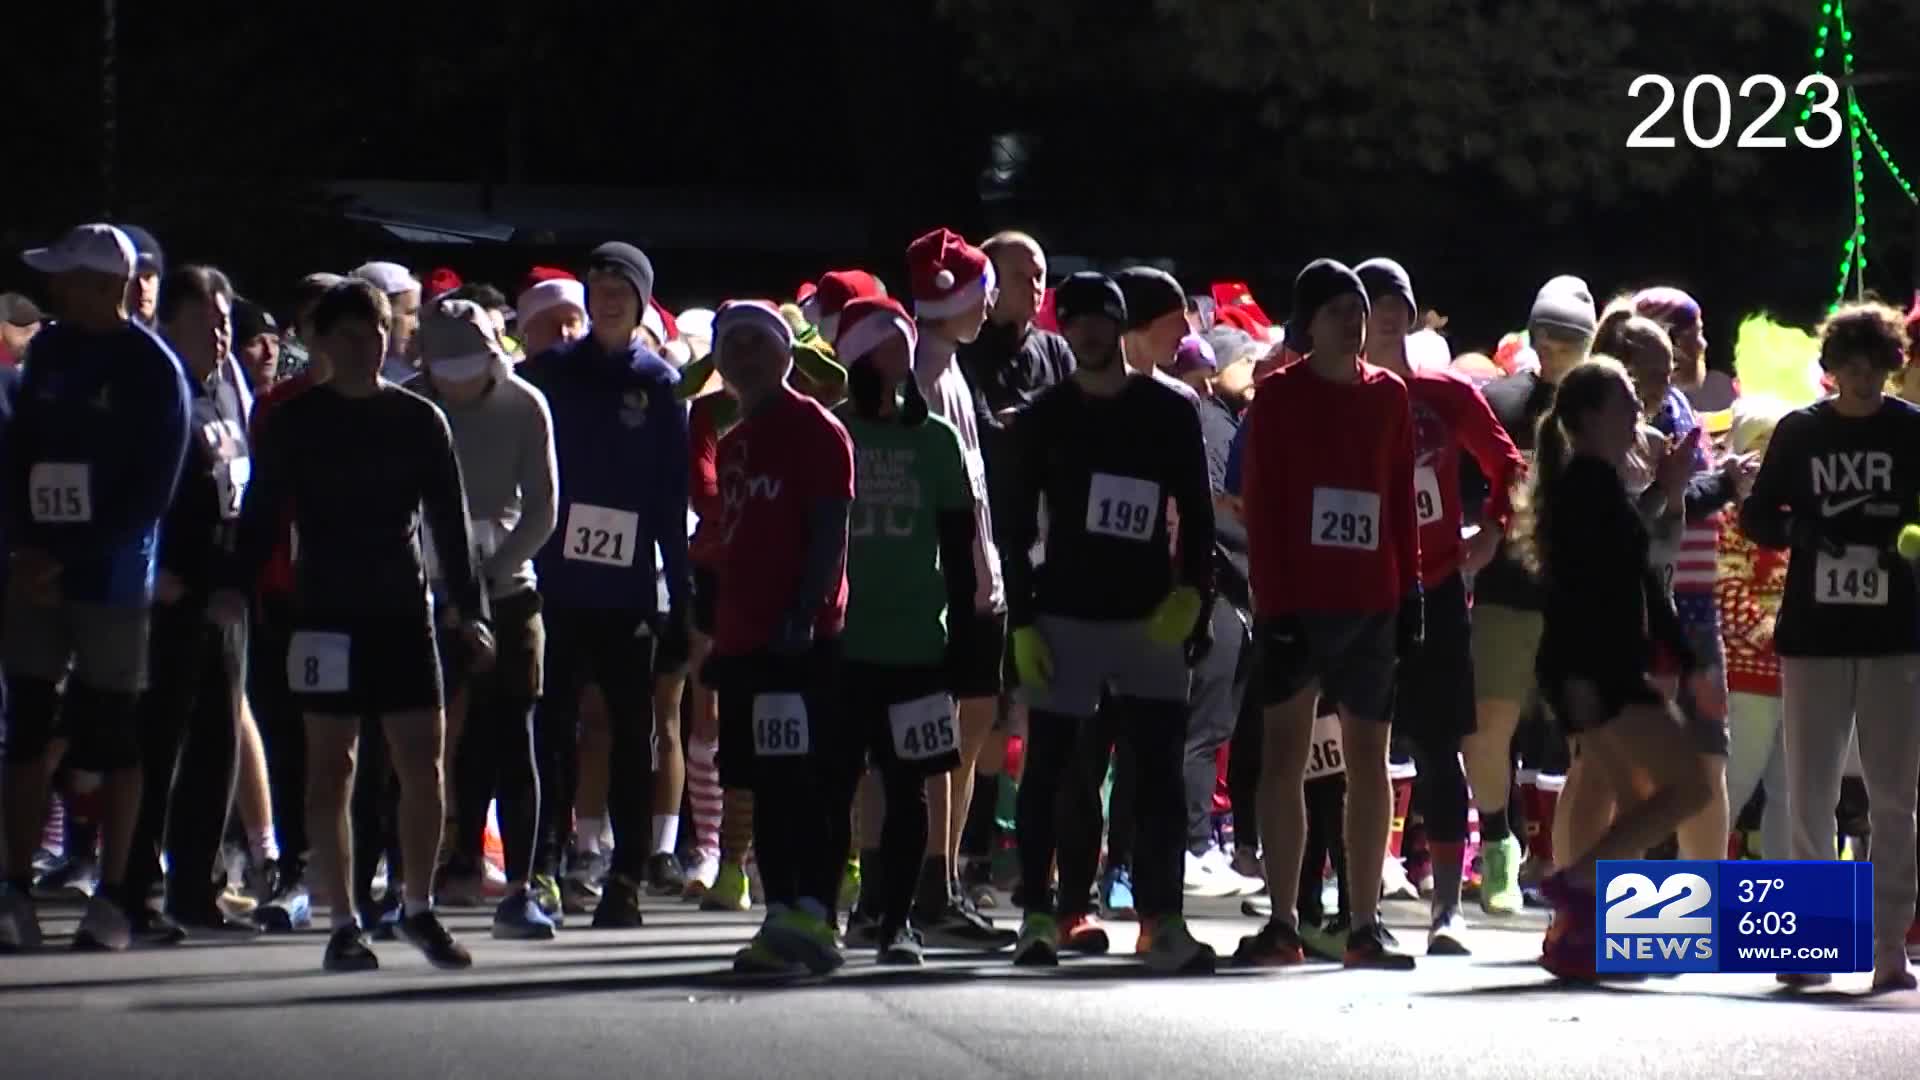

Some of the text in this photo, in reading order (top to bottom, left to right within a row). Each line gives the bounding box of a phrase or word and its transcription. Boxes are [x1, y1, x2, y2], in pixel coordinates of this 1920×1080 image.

[1811, 450, 1893, 496] NXR
[35, 487, 82, 517] 515
[1099, 497, 1150, 534] 199
[573, 526, 623, 561] 321
[1320, 511, 1372, 545] 293
[1827, 568, 1879, 598] 149
[304, 655, 320, 688] 8
[903, 715, 954, 754] 485
